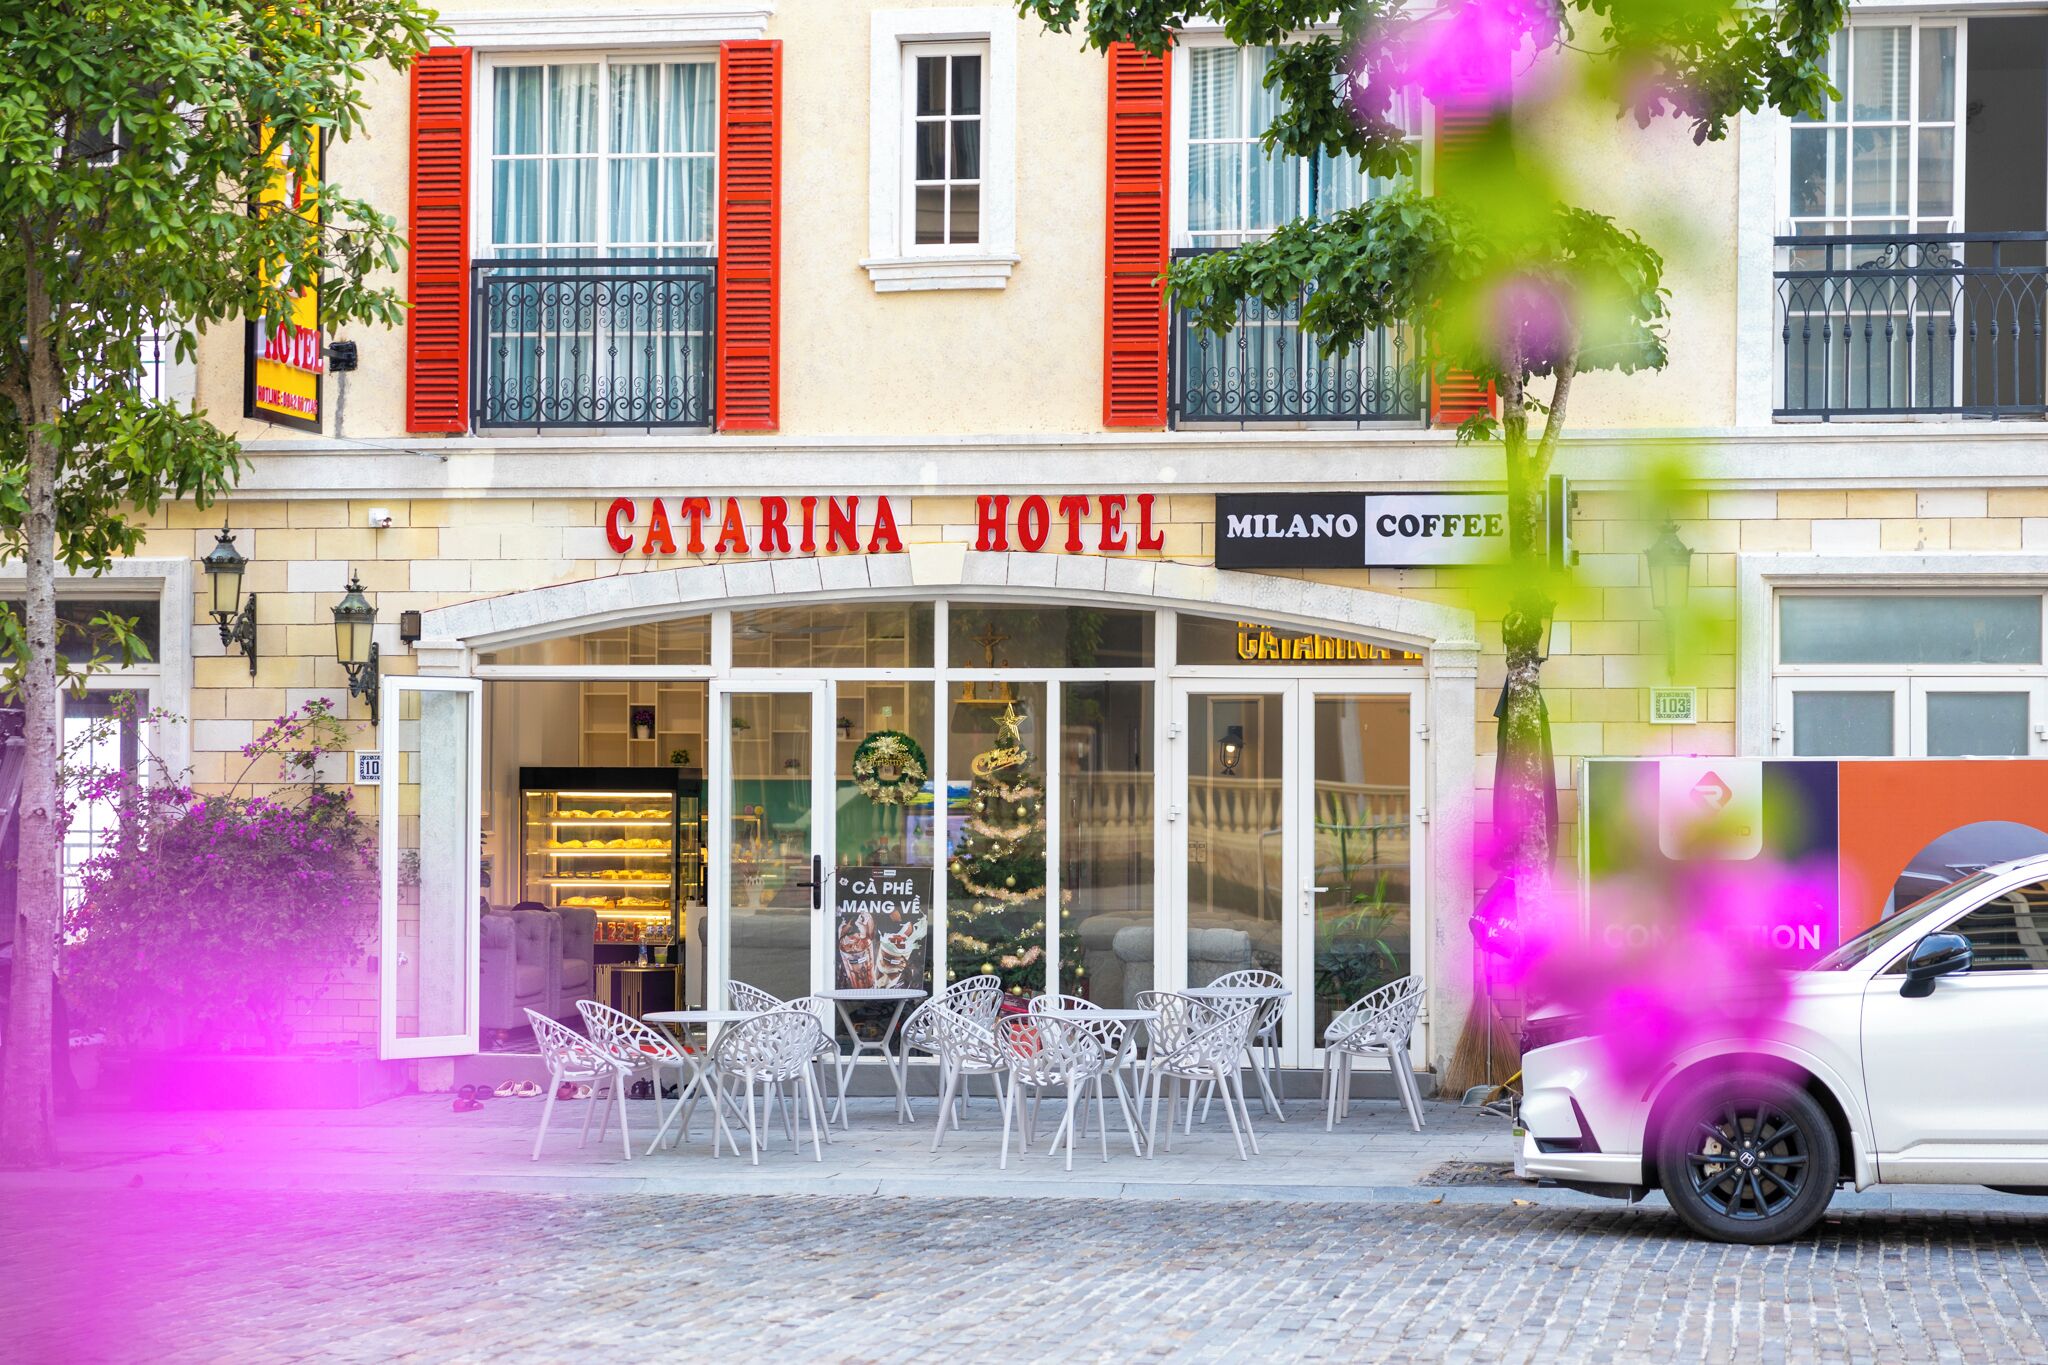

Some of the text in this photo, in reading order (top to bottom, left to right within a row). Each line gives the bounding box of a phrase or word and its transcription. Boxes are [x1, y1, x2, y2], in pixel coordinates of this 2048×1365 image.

[605, 493, 1166, 555] CATARINA HOTEL
[1226, 513, 1504, 539] MILANO COFFEE
[1662, 698, 1686, 713] 103
[852, 878, 914, 895] CÀ PHÊ
[842, 894, 921, 914] MANG VỀ
[1603, 923, 1821, 951] COMTION
